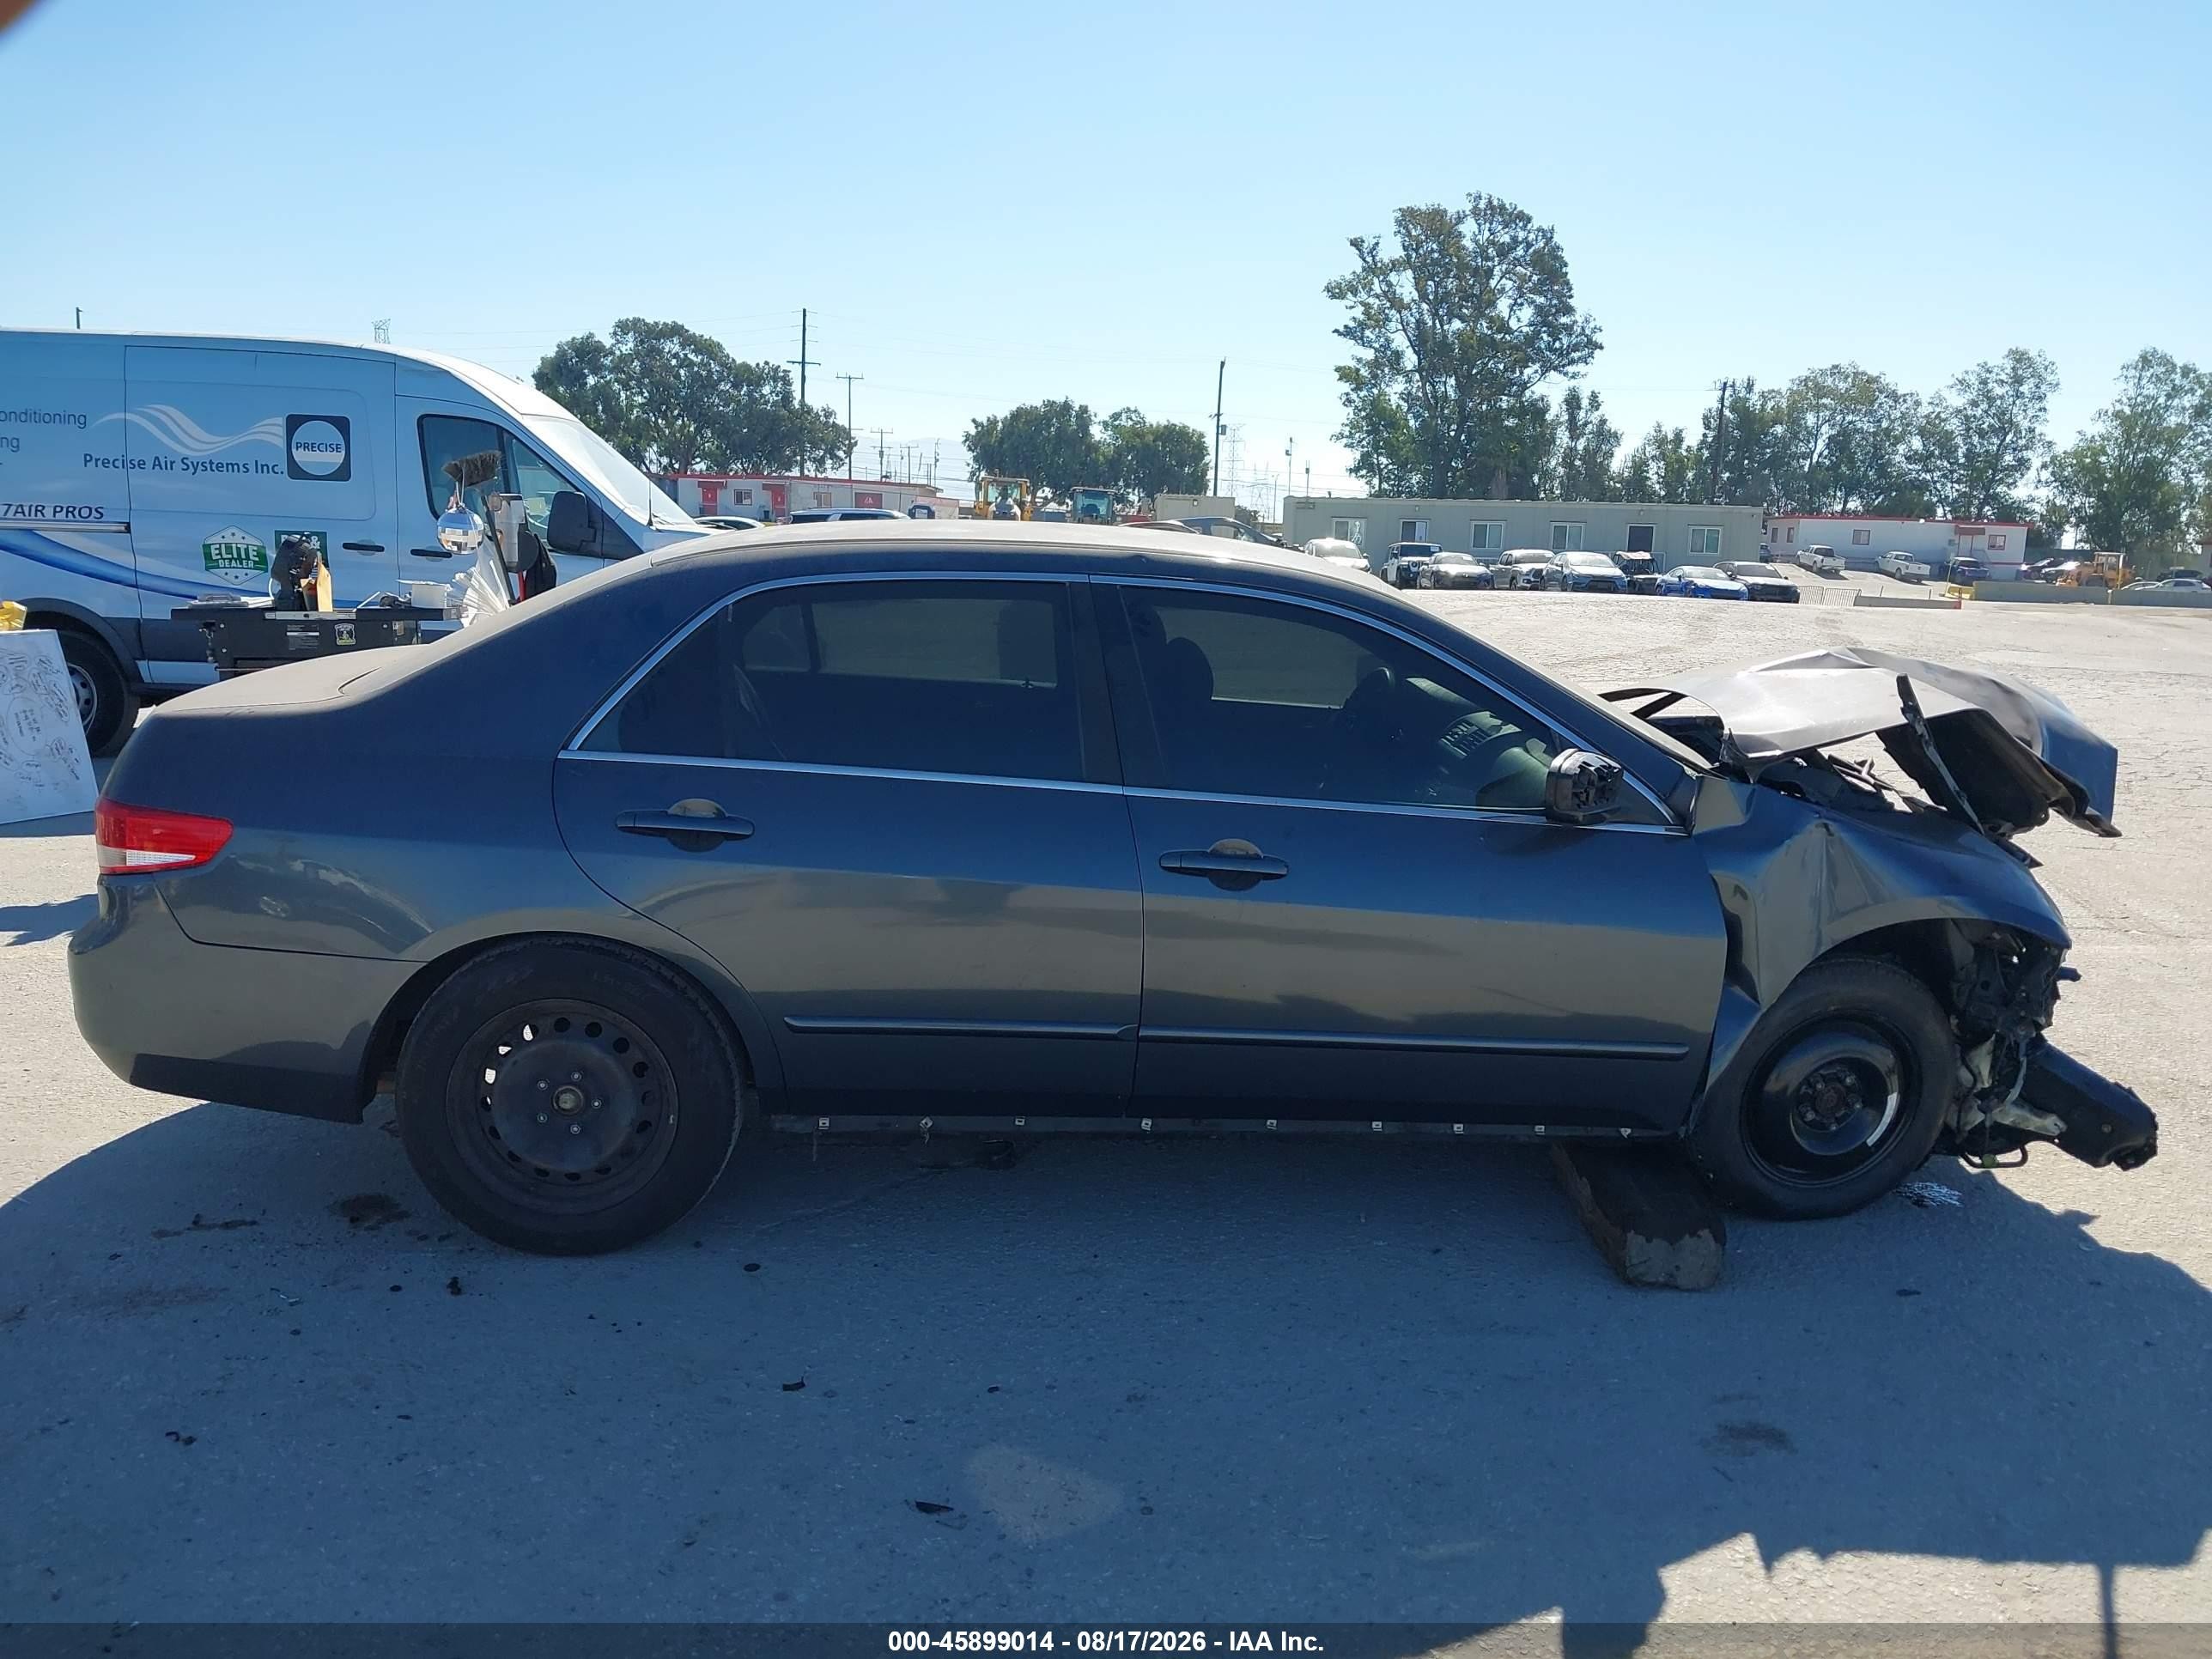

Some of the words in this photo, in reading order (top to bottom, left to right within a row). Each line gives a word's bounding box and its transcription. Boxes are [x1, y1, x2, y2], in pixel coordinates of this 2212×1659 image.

[295, 441, 343, 453] PRECISE
[83, 453, 146, 470] Precise
[152, 456, 175, 471] Air
[181, 457, 249, 475] Systems
[255, 460, 284, 475] Inc.
[52, 505, 104, 520] PROS
[210, 544, 259, 561] ELITE
[218, 559, 254, 568] DEALER
